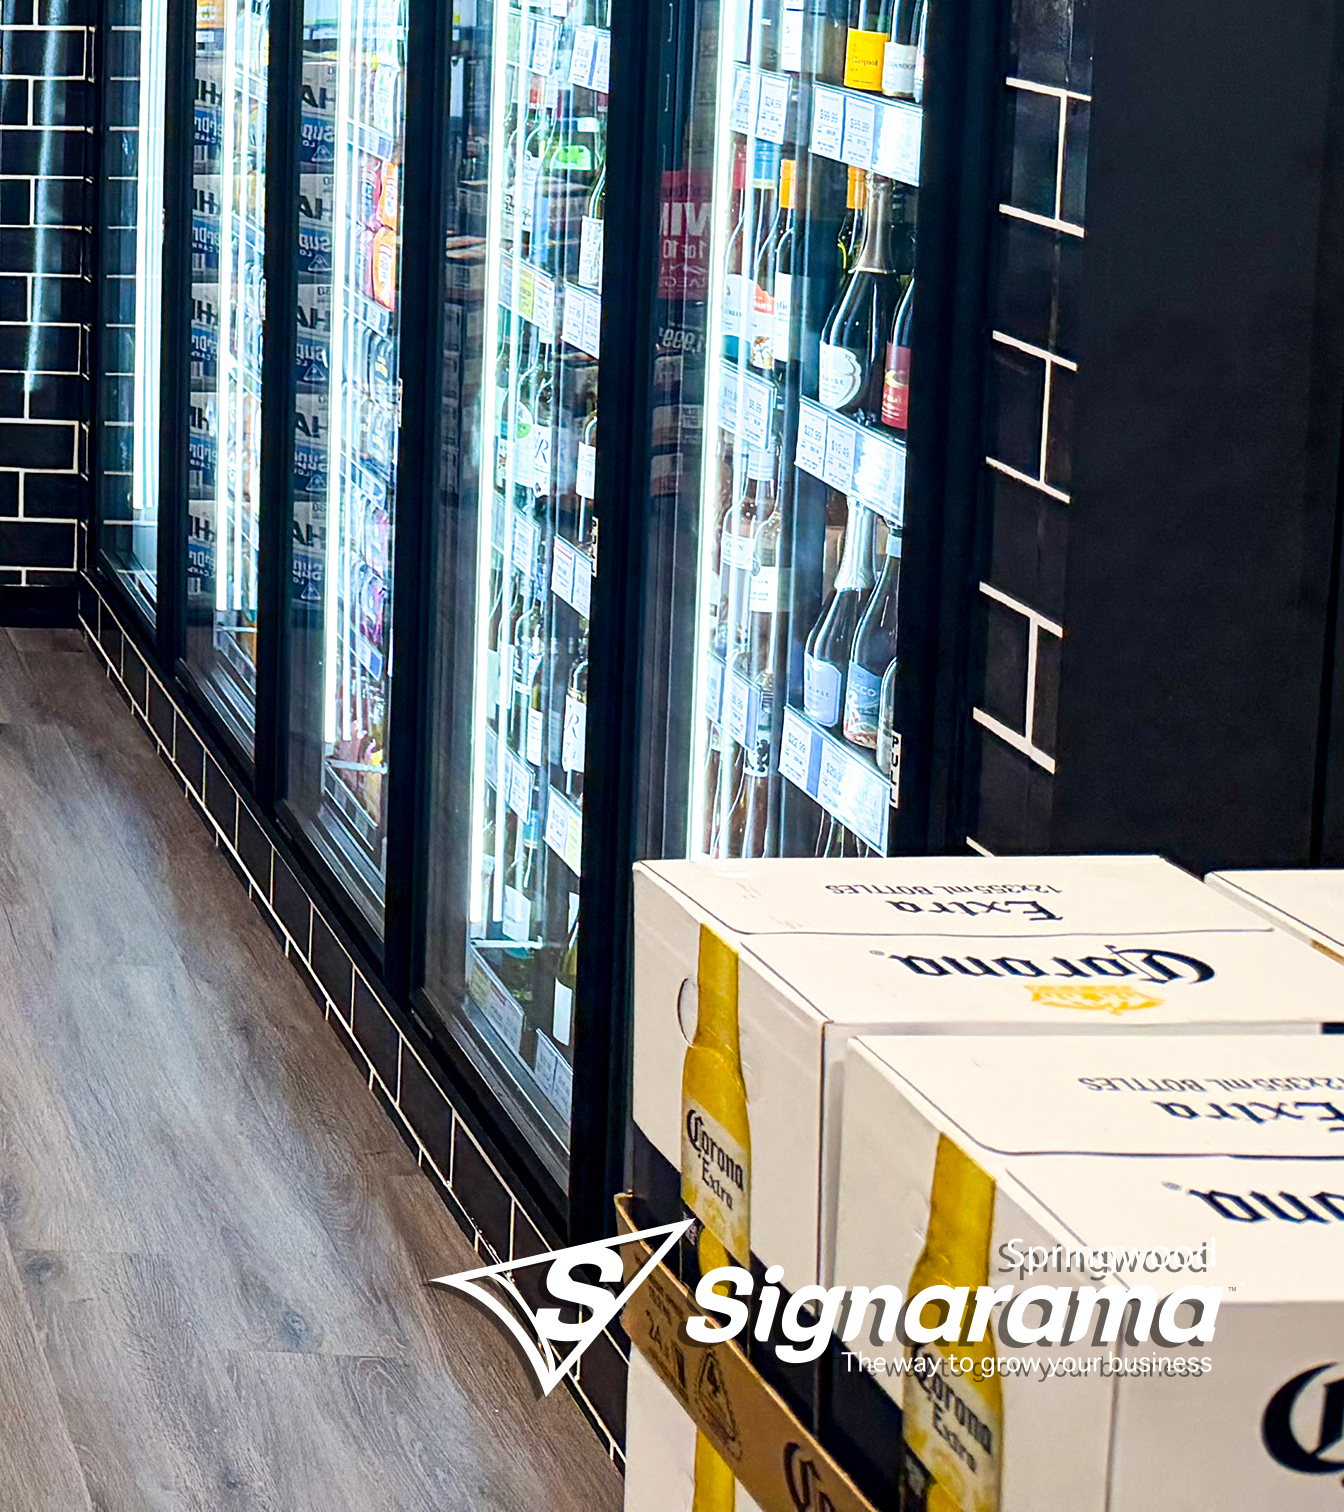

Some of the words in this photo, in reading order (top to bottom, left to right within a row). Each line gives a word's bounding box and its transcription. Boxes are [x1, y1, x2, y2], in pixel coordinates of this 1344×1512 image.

[886, 901, 1063, 921] Extra
[889, 945, 1215, 984] Corona
[685, 1108, 745, 1192] Corona
